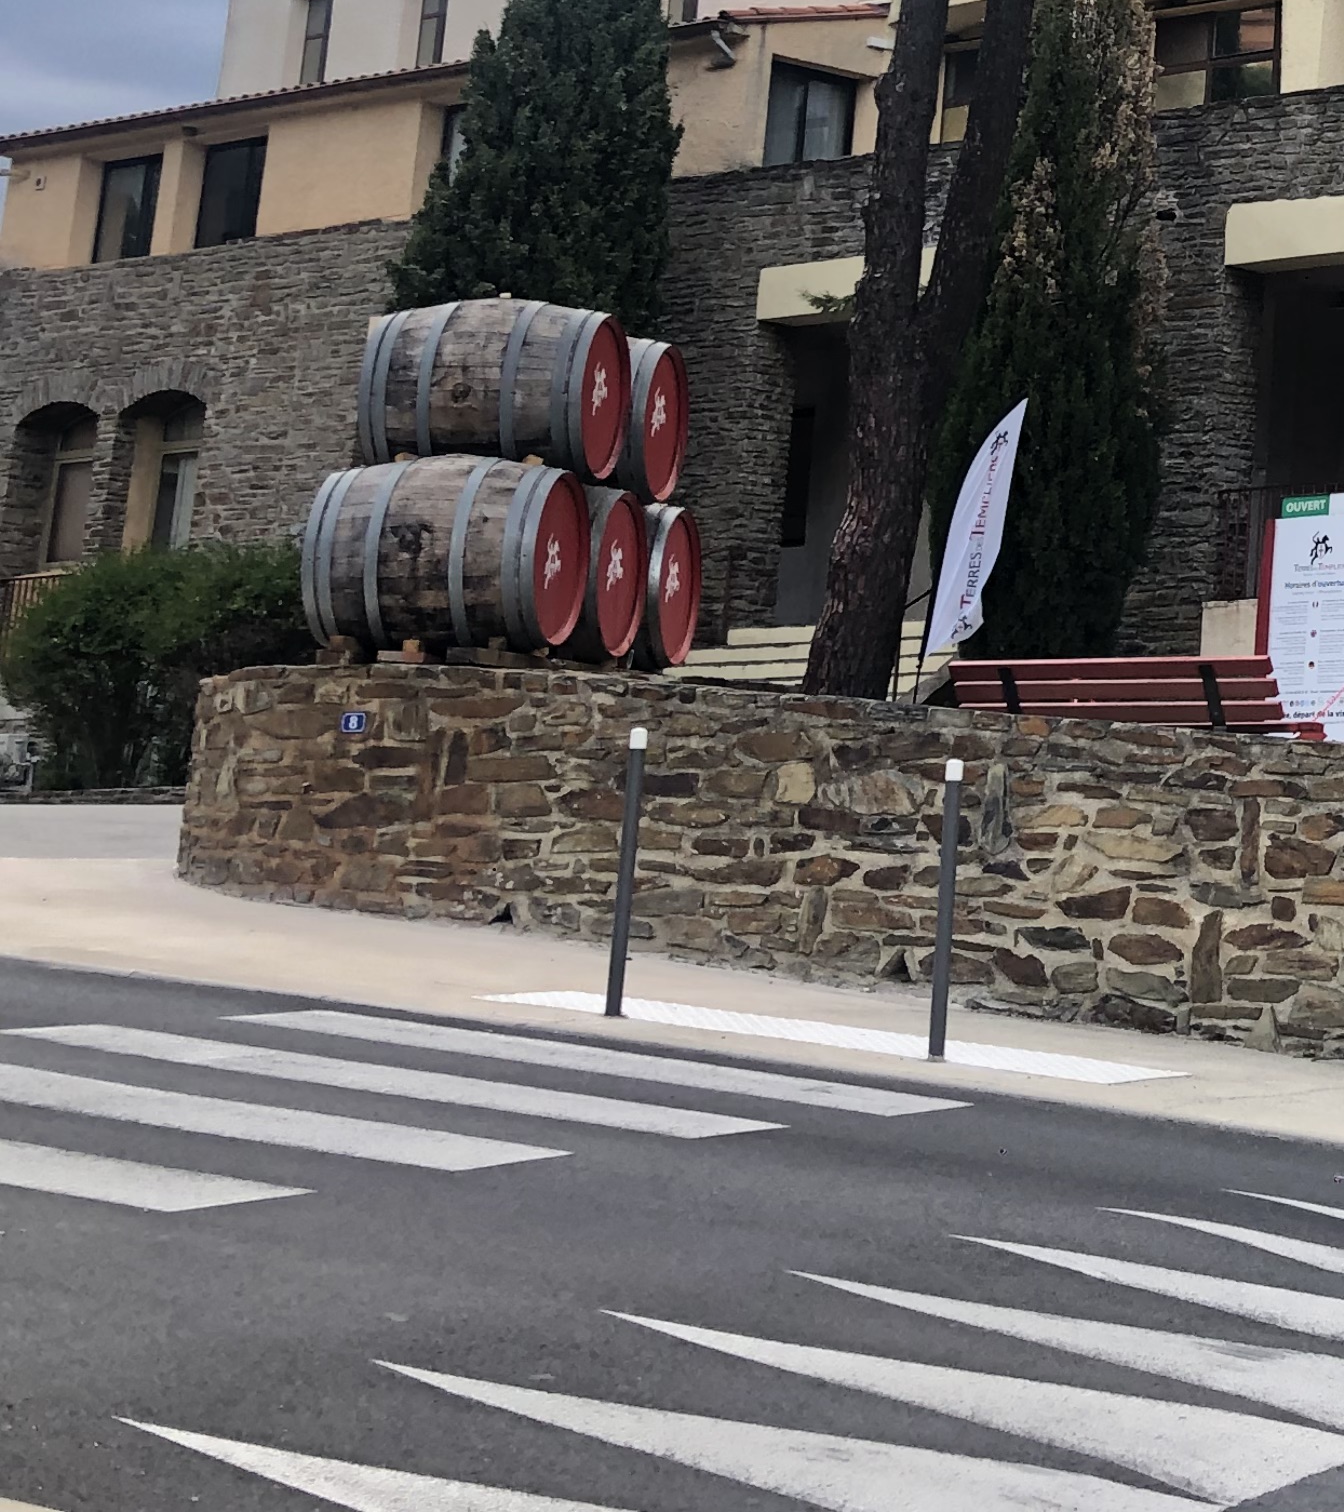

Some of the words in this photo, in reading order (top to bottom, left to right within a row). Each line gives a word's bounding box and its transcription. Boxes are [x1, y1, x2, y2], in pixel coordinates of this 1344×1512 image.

[1286, 499, 1326, 513] OUVERT
[960, 552, 981, 609] TERRES
[348, 715, 358, 729] 8
